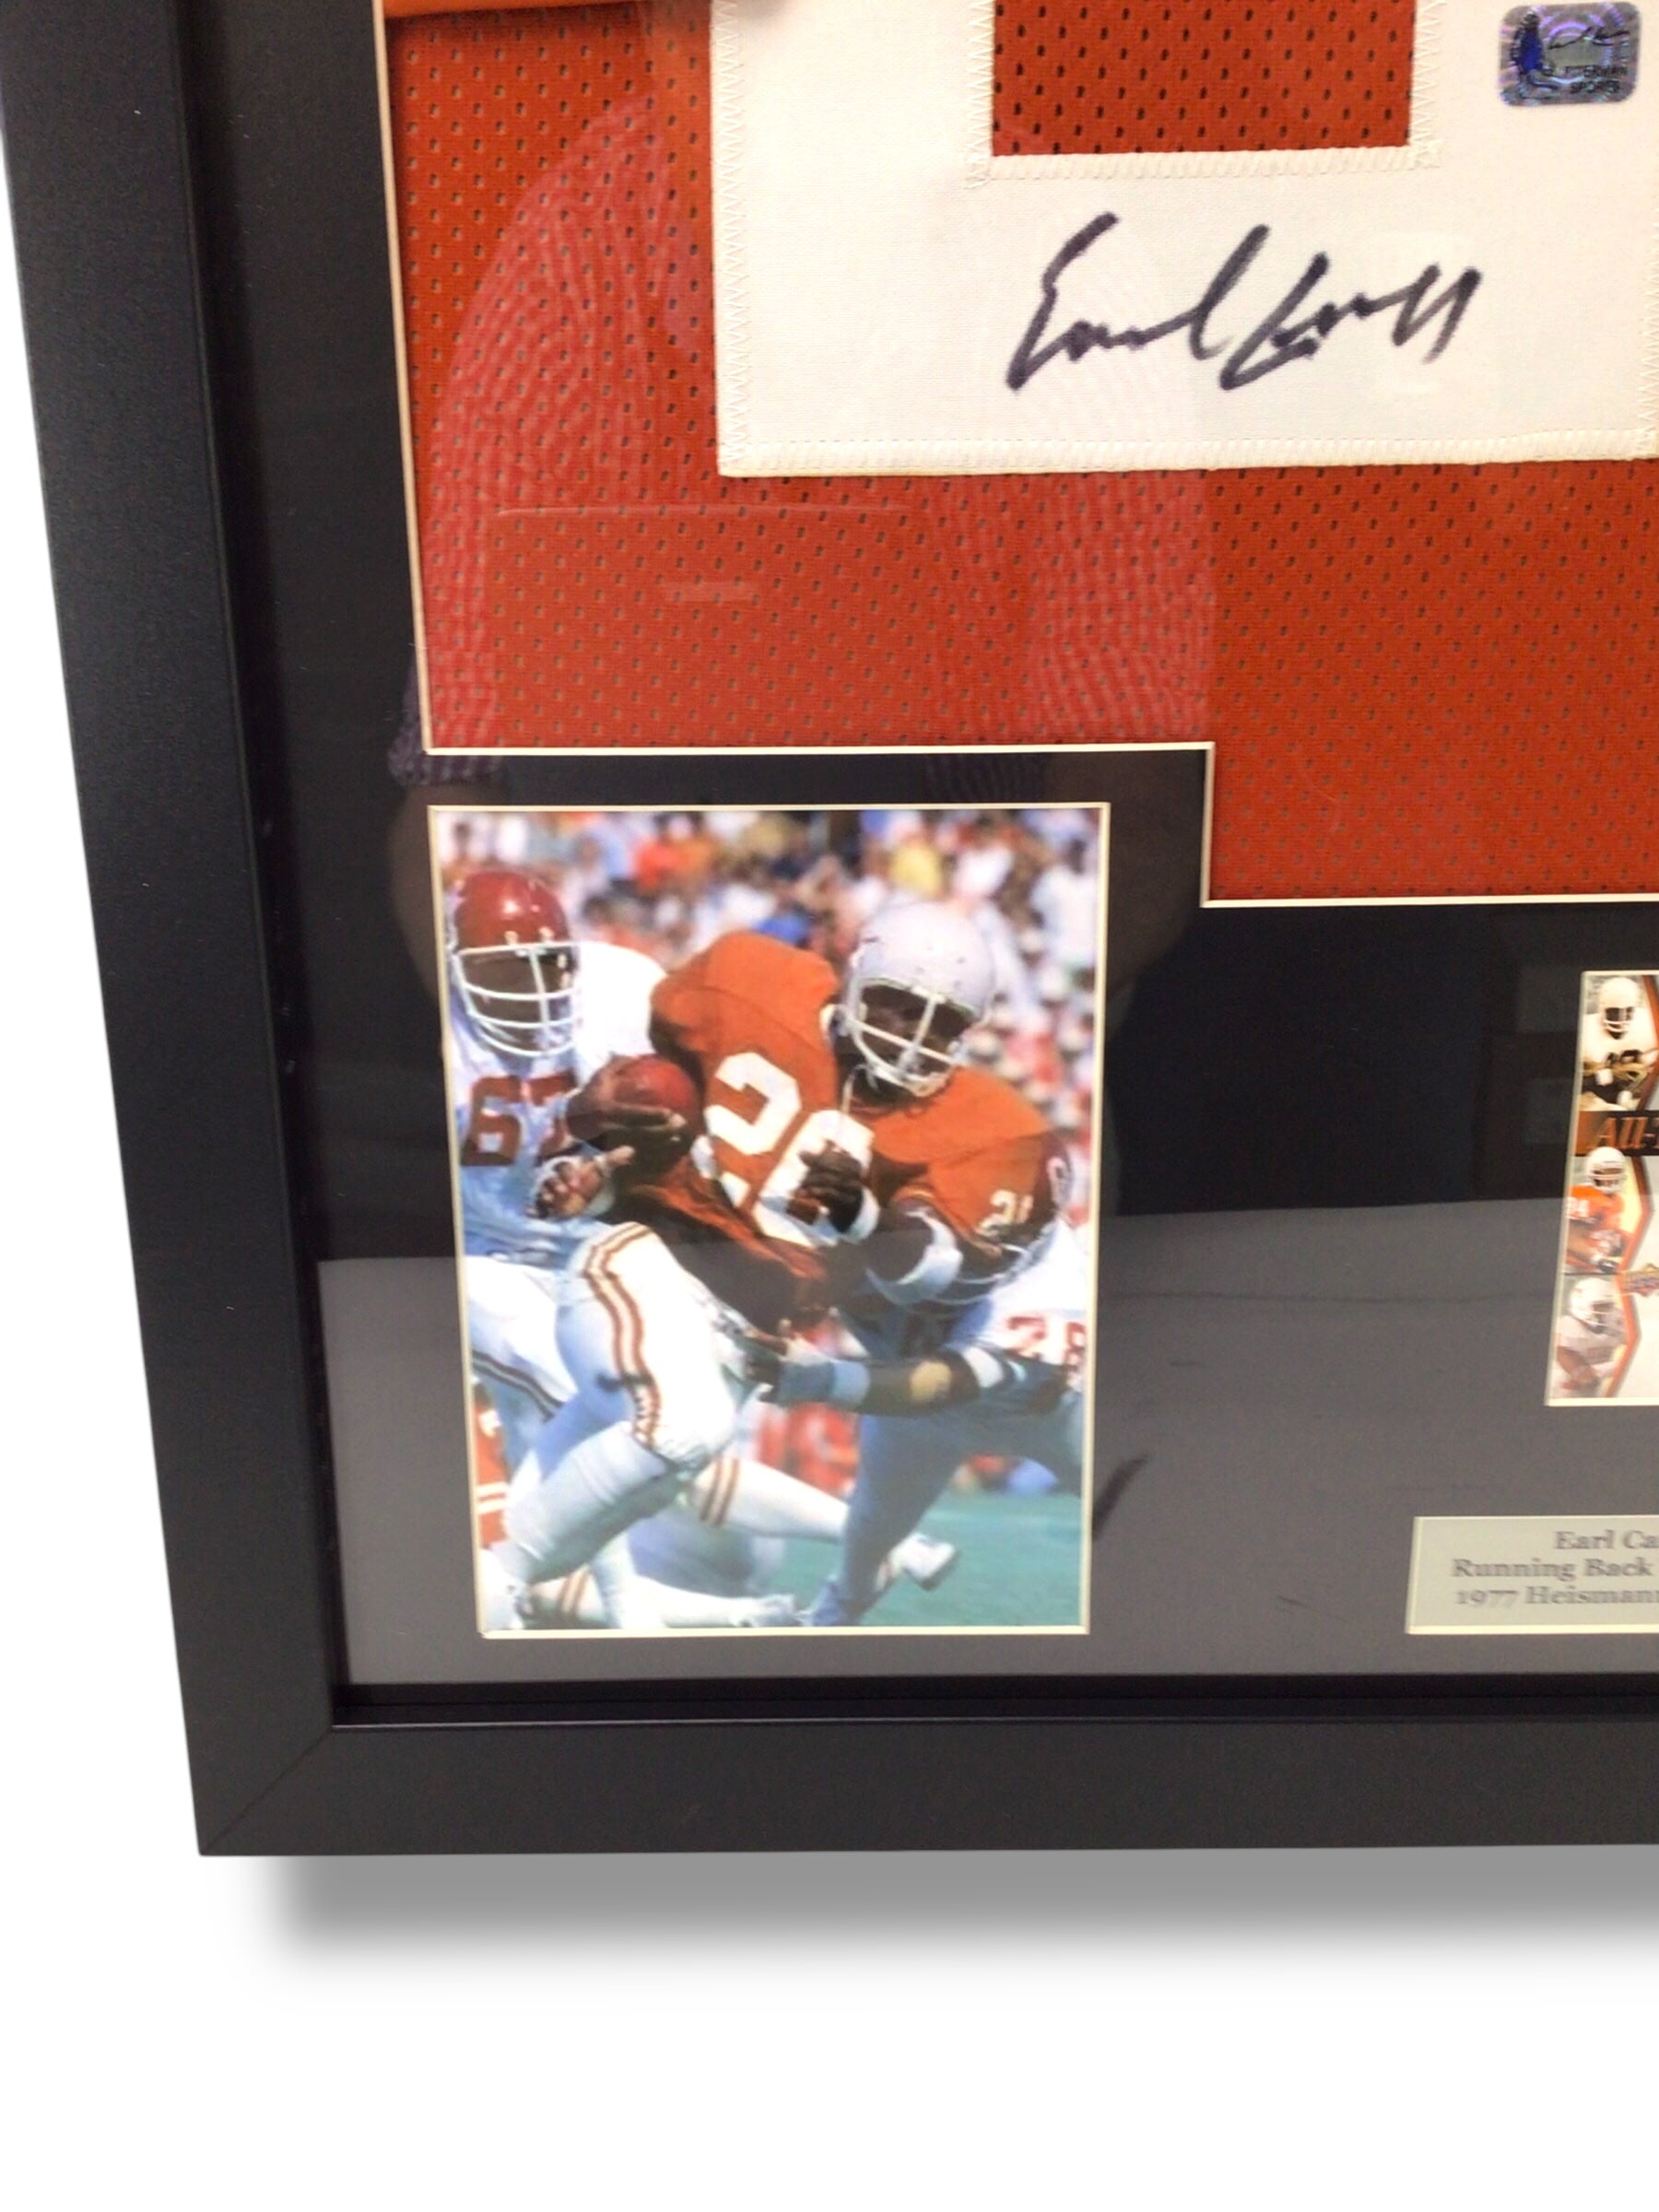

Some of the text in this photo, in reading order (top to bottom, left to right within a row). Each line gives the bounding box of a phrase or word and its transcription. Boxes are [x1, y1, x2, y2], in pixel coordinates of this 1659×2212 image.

[461, 1067, 578, 1166] 67
[1595, 1115, 1659, 1149] All-
[1554, 1530, 1616, 1549] Earl
[1450, 1557, 1653, 1582] Running Back
[1456, 1589, 1520, 1608] 1977
